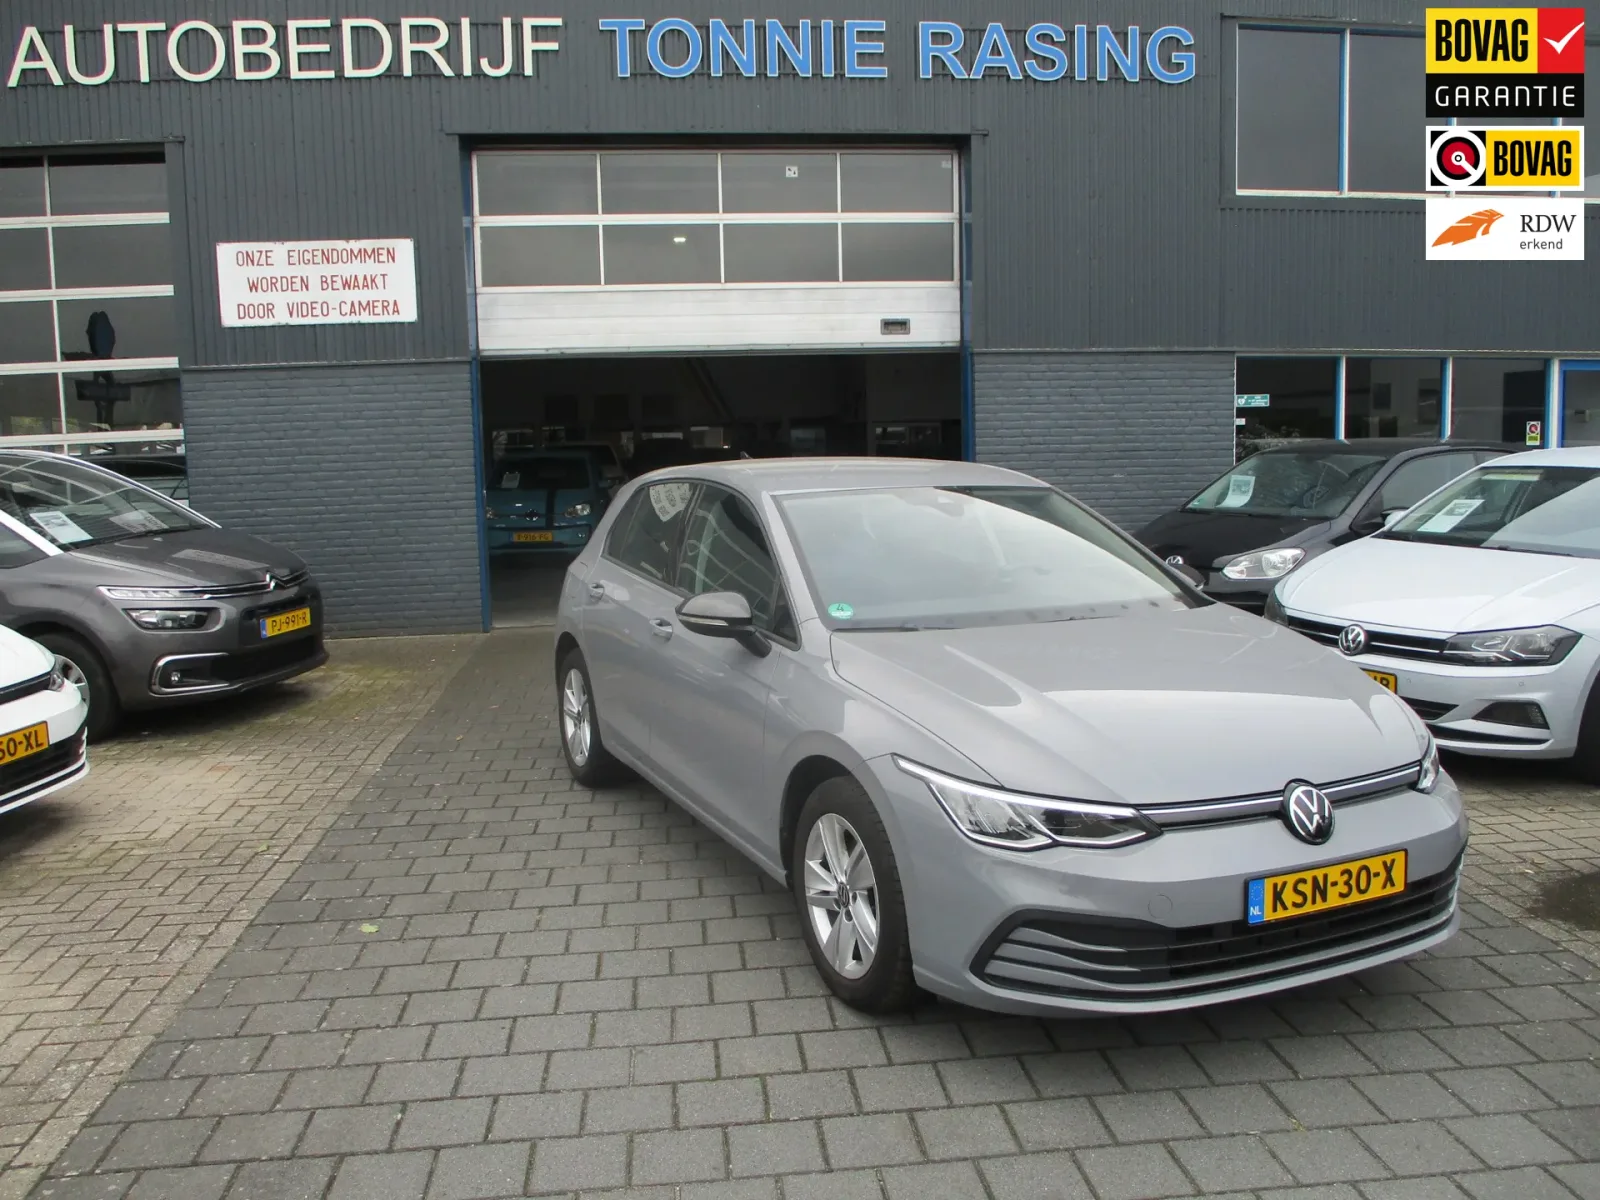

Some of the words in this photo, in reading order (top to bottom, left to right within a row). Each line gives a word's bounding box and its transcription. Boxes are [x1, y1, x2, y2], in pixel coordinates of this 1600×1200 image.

[7, 16, 563, 88] AUTOBEDRIJF
[599, 18, 888, 79] TONNIE
[918, 21, 1196, 84] RASING
[236, 250, 274, 267] ONZE
[287, 247, 396, 266] EIGENDOMMEN
[247, 275, 310, 293] WORDEN
[320, 274, 388, 292] BEWAAKT
[237, 303, 275, 320] DOOR
[287, 299, 400, 319] VIDEO-CAMERA
[271, 611, 307, 633] PJ-991-R
[1250, 905, 1262, 916] NL
[1272, 858, 1396, 913] KSN-30-X
